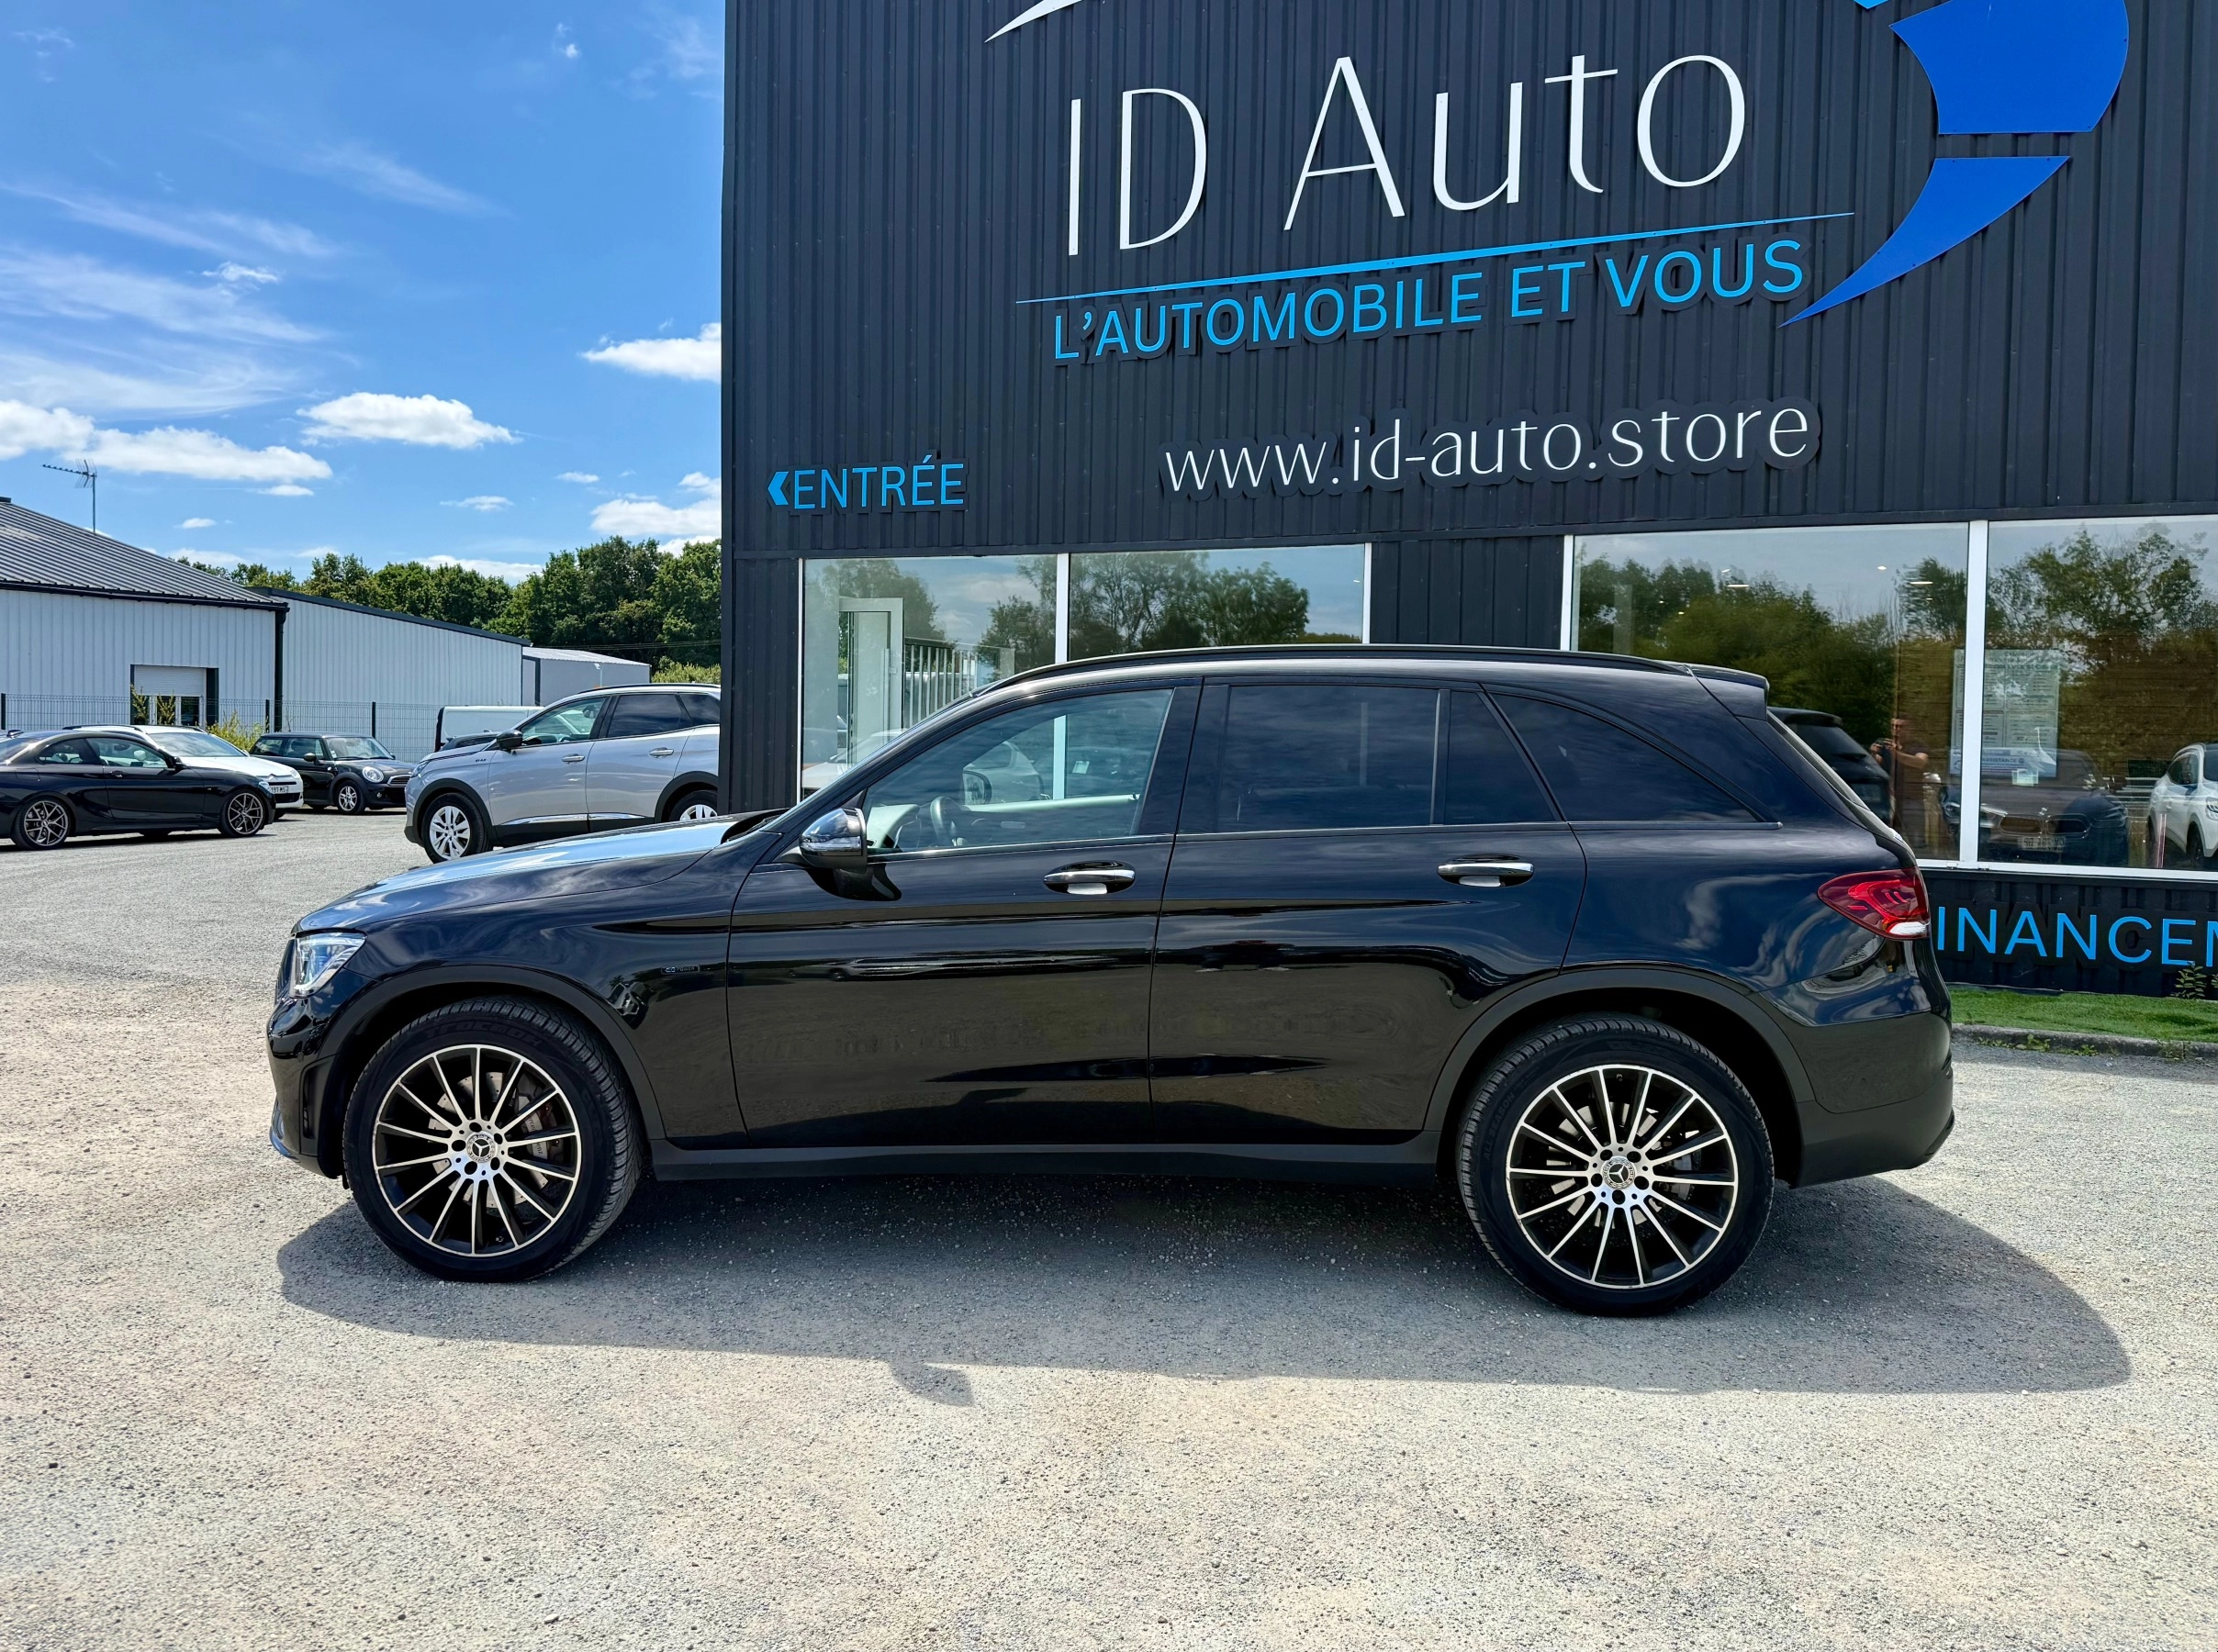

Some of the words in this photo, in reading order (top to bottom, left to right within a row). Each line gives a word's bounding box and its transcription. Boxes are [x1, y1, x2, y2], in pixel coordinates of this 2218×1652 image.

[1069, 88, 1207, 256] ID
[1283, 54, 1746, 230] Auto
[1054, 272, 1484, 359] L'AUTOMOBILE
[1510, 261, 1586, 318] ET
[1605, 240, 1804, 308] VOUS
[794, 454, 964, 509] ENTRÉE
[1165, 407, 1808, 493] www.id-auto.store
[1937, 906, 2218, 967] INANCE
